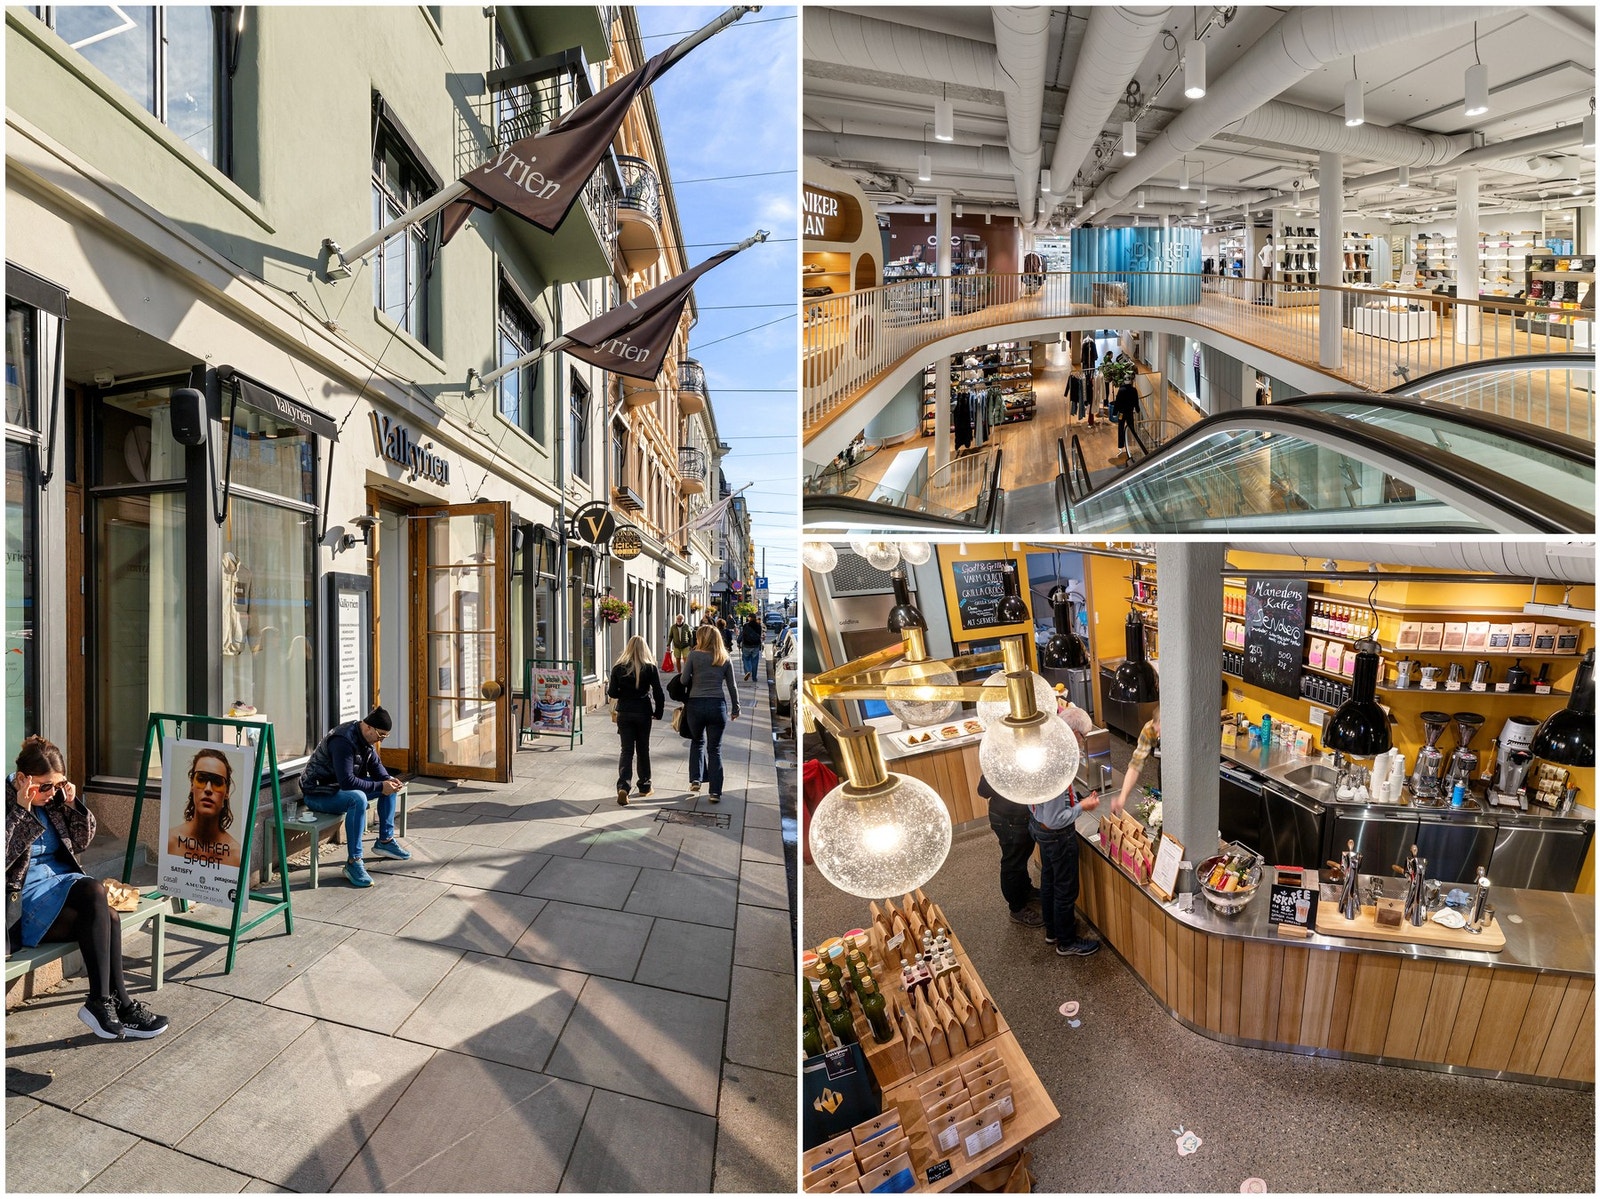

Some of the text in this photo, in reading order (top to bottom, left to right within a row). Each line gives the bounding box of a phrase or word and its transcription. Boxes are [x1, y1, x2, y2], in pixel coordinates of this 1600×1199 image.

[484, 146, 561, 200] yrien
[803, 214, 825, 236] AN
[593, 336, 650, 362] yrien
[273, 393, 312, 426] Valkyrien
[369, 409, 450, 485] Valkyrien
[583, 510, 608, 543] V
[758, 579, 766, 588] P
[1253, 581, 1302, 601] Månedens
[1264, 597, 1294, 610] Kaffe
[178, 835, 230, 857] MONIKER
[170, 865, 193, 875] SATISFY
[184, 852, 223, 870] SPORT
[185, 882, 220, 893] AMUNDSEN
